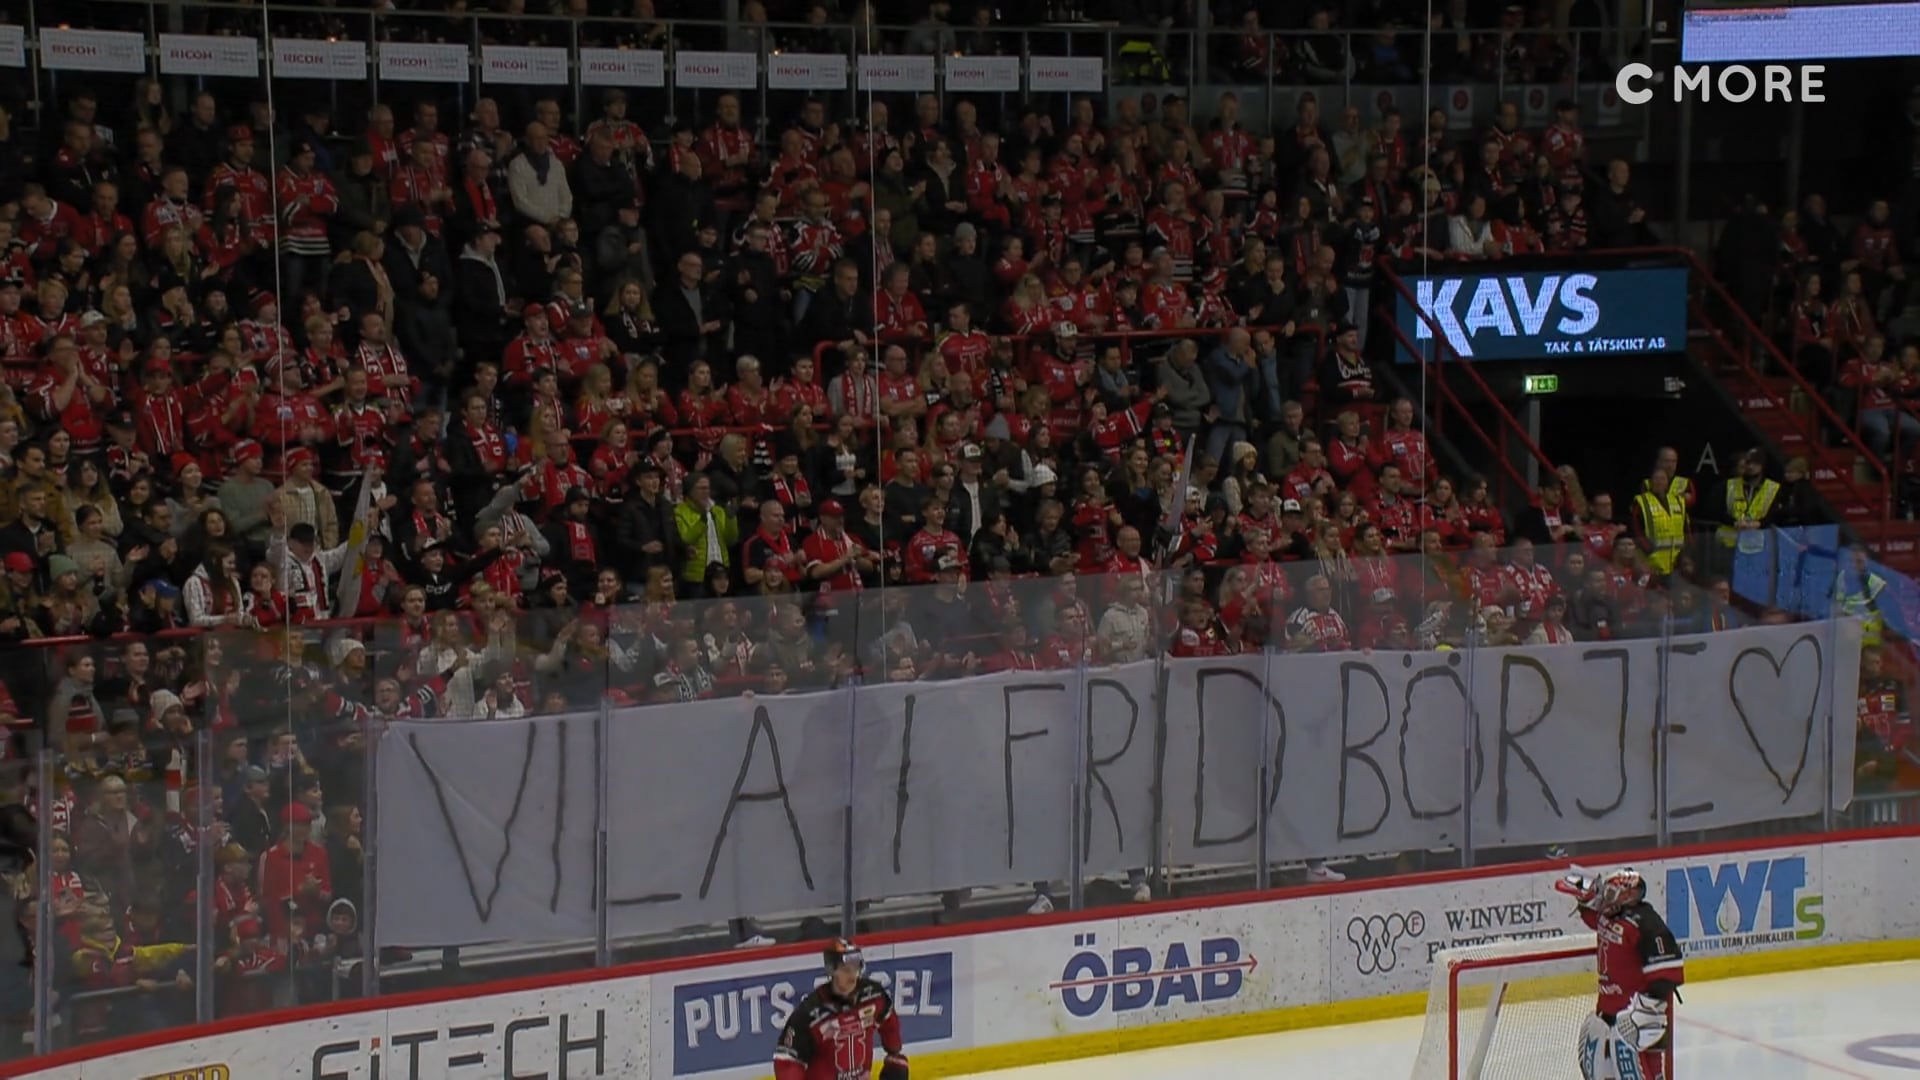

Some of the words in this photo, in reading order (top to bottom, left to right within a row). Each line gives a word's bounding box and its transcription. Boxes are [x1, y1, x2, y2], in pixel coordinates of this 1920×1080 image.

[52, 44, 97, 55] RICOH
[170, 49, 213, 61] RICOH
[283, 53, 324, 65] RICOH
[389, 57, 428, 68] RICOH
[491, 60, 528, 70] RICOH
[589, 62, 626, 73] RICOH
[684, 65, 720, 75] RICOH
[776, 66, 811, 77] RICOH
[866, 68, 899, 78] RICOH
[953, 69, 986, 79] RICOH
[1037, 70, 1070, 79] RICOH
[1416, 273, 1600, 357] KAVS
[1544, 340, 1571, 354] TAK
[1574, 340, 1584, 353] &
[1588, 337, 1646, 353] TÄTSKIKT
[1648, 337, 1666, 350] AB
[1695, 441, 1719, 476] A
[408, 704, 816, 923] VILA
[892, 694, 916, 874] I
[1003, 666, 1287, 870] FRID
[1338, 641, 1715, 842] BÖRJE
[1689, 939, 1720, 952] VATTEN
[1721, 936, 1743, 948] UTAN
[1745, 930, 1795, 945] KEMIKALIER
[1061, 933, 1244, 1018] ÖBAB
[684, 981, 797, 1048] PUTS
